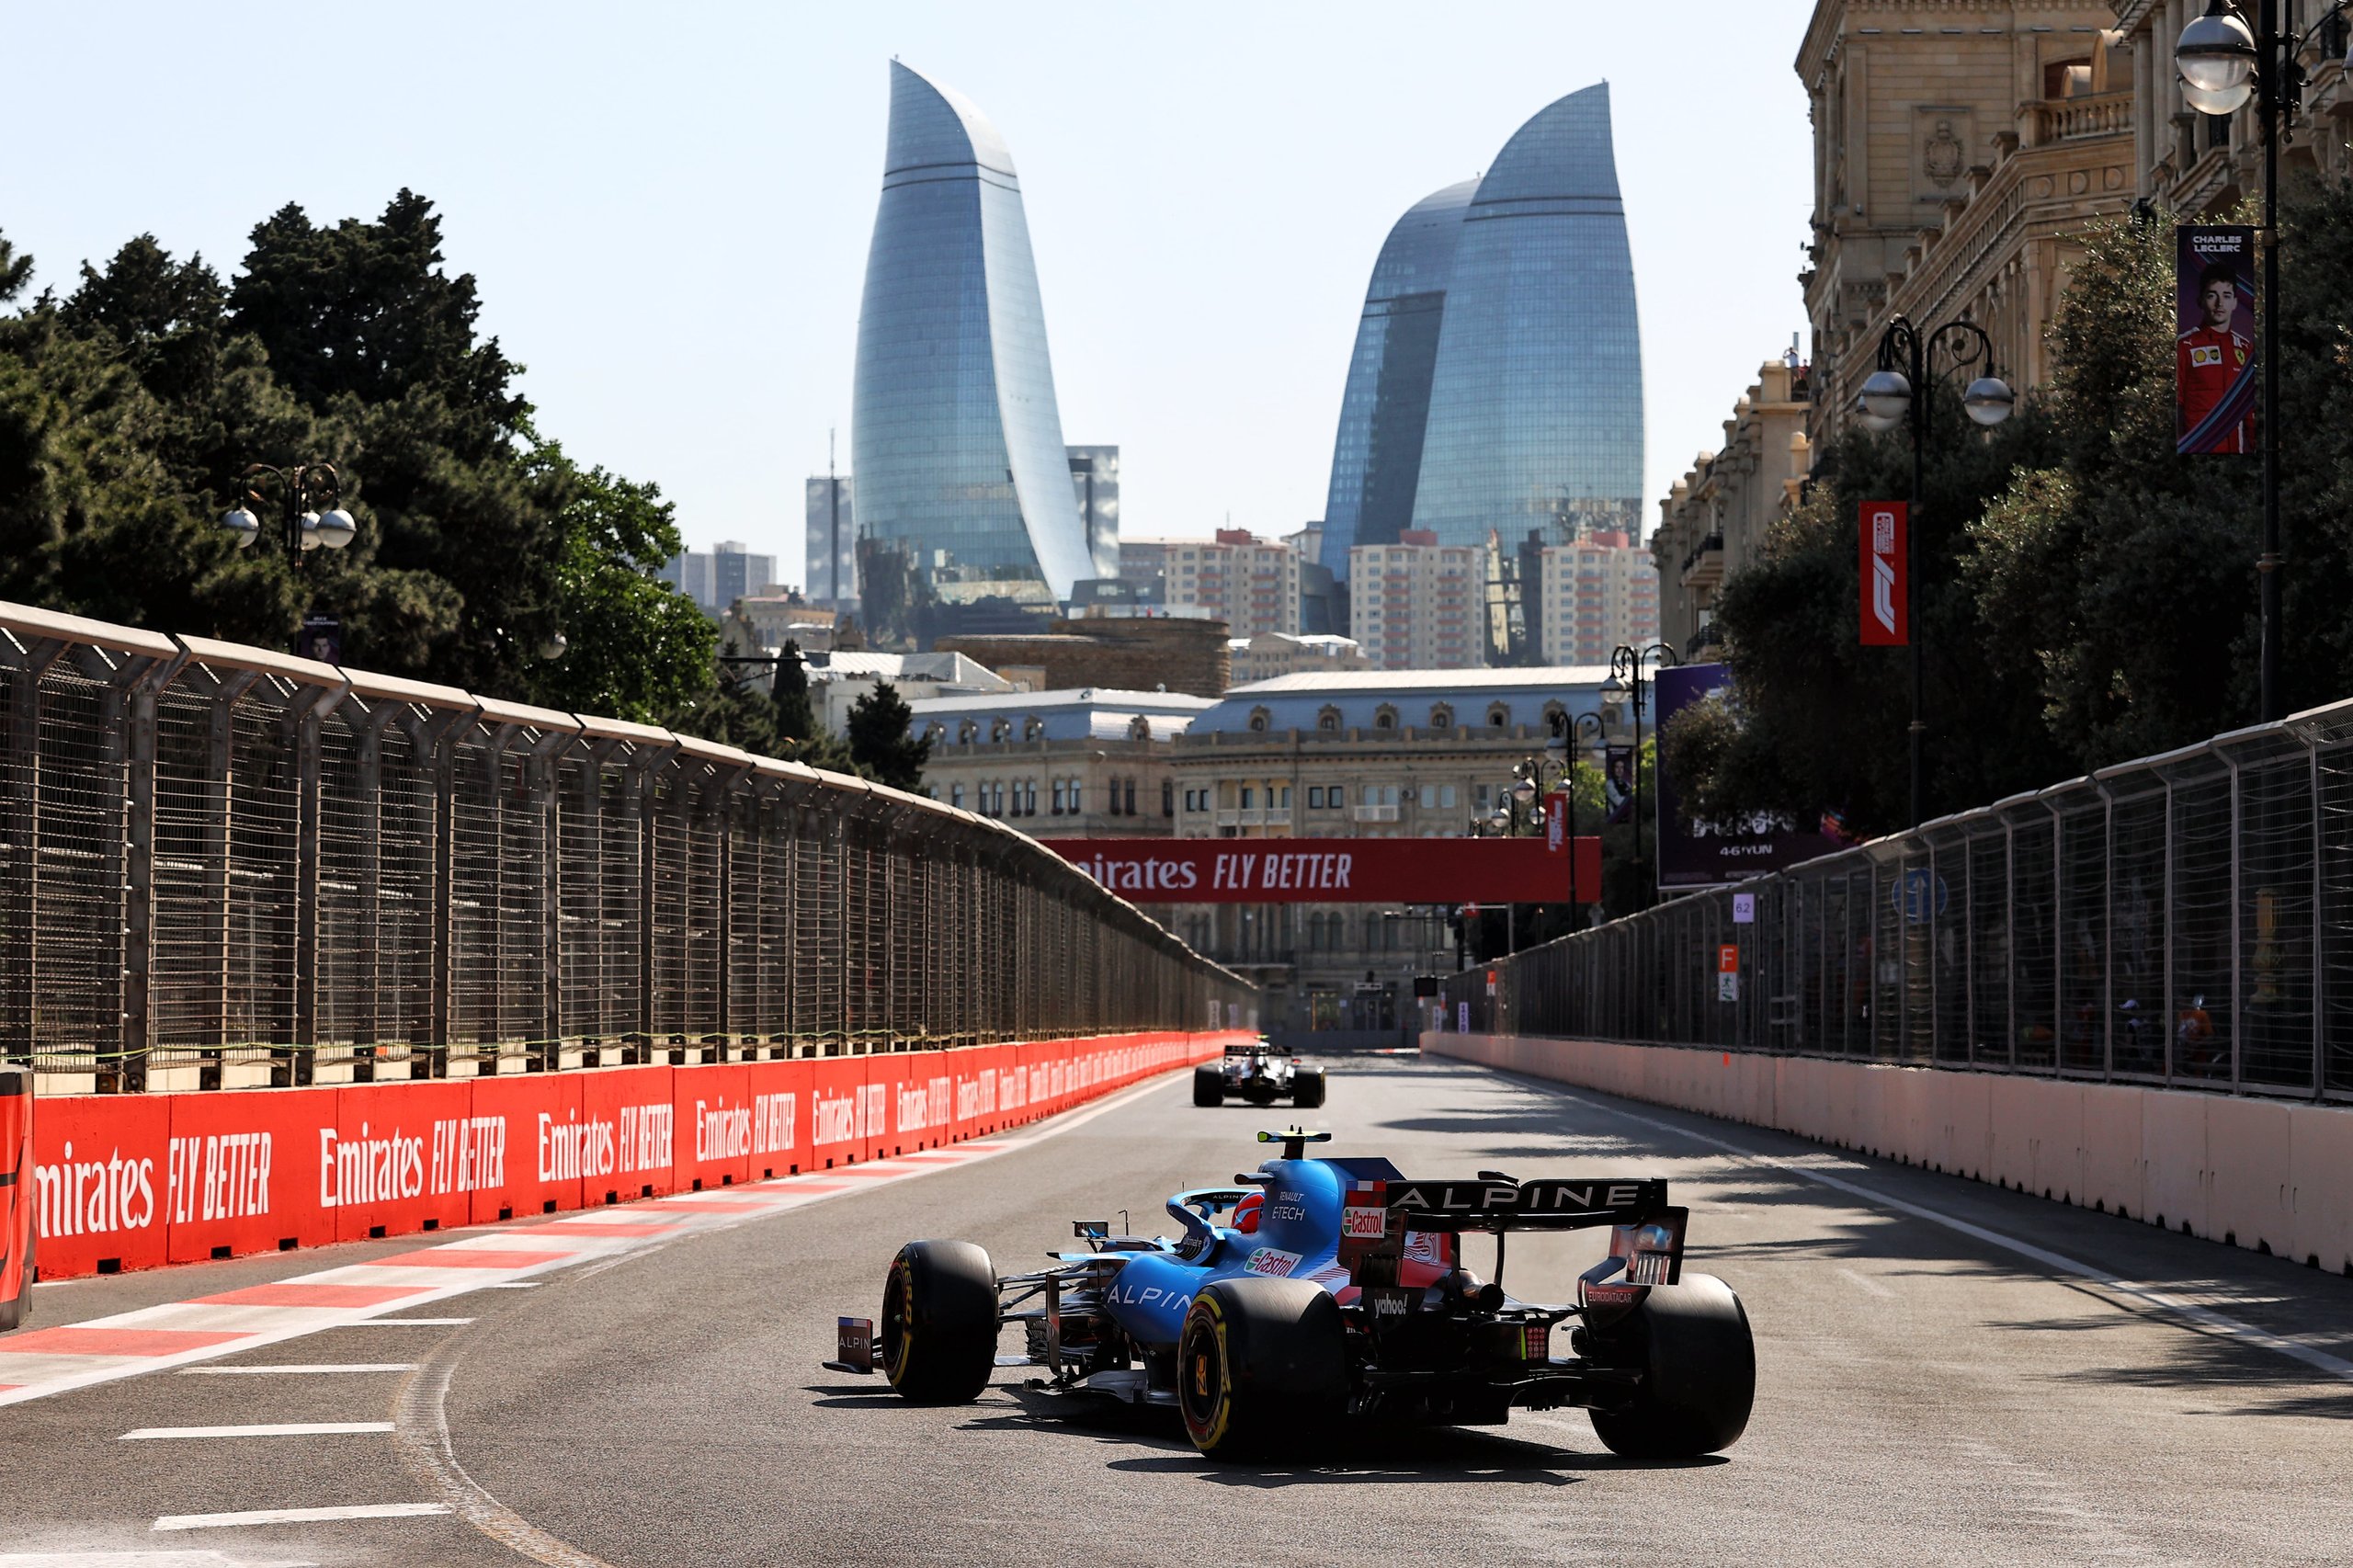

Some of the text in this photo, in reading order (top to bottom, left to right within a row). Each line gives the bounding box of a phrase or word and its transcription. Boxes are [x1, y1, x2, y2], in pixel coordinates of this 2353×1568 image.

[2193, 235, 2243, 244] CHARLES
[2194, 244, 2241, 253] LECLERC
[1075, 852, 1352, 890] irates FLY BETTER
[1722, 949, 1734, 969] F
[696, 1092, 796, 1163] Emirates FLY BETTER
[813, 1086, 854, 1146] Emirates
[538, 1103, 674, 1183] Emirates FLY BETTER
[319, 1116, 506, 1209] Emirates FLY BETTER
[35, 1131, 272, 1238] mirates FLY BETTER
[1279, 1192, 1304, 1202] RENAULT
[1390, 1185, 1639, 1209] ALPINE
[1352, 1210, 1383, 1233] Castrol
[1255, 1251, 1298, 1277] Castrol
[1107, 1284, 1192, 1310] ALPIN
[1374, 1292, 1408, 1319] yahoo!
[1588, 1291, 1632, 1303] EURODATACAR
[838, 1336, 871, 1350] ALPIN
